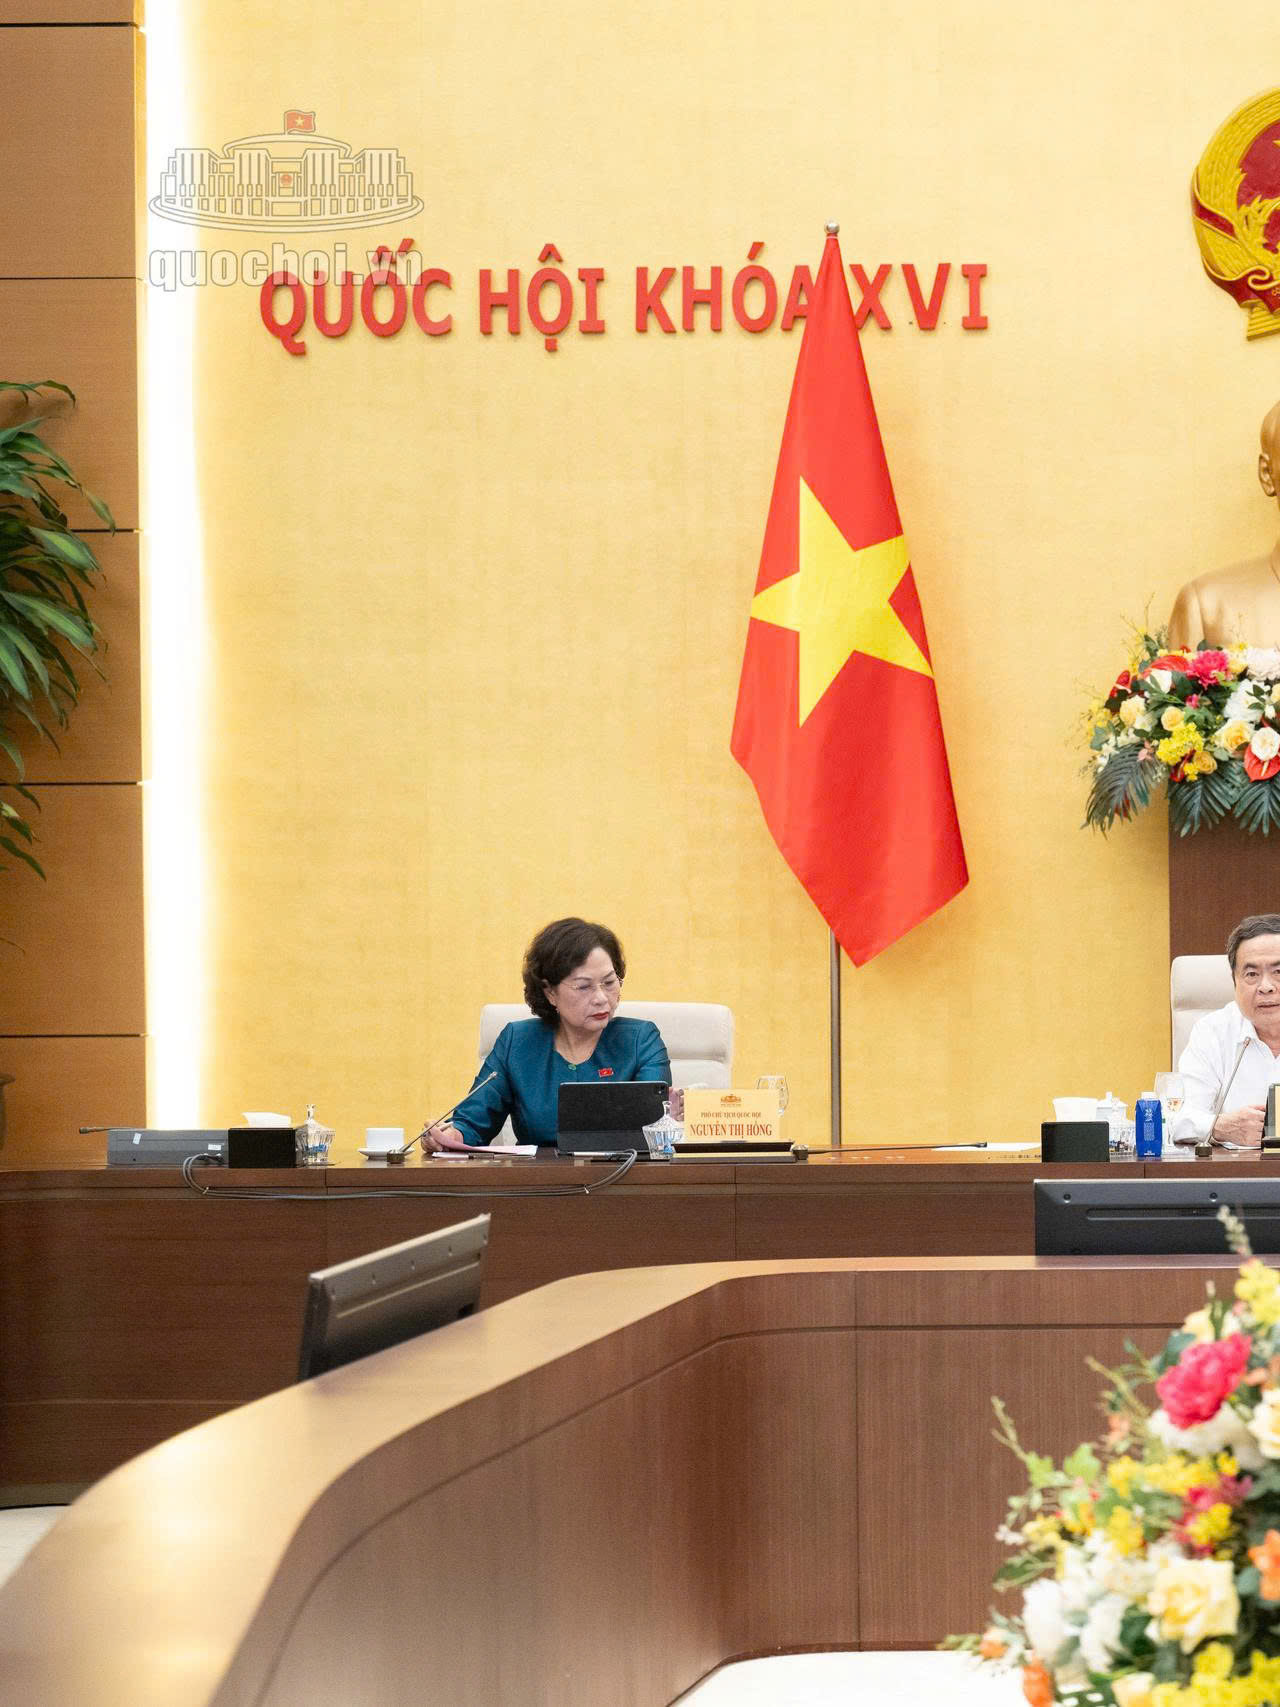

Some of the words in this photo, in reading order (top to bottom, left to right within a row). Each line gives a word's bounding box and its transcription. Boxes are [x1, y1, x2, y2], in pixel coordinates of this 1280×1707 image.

[259, 238, 453, 358] QUỐC
[479, 243, 607, 353] HỘI
[635, 241, 816, 335] KHÓA
[849, 262, 989, 332] XVI
[729, 1123, 744, 1139] THỊ
